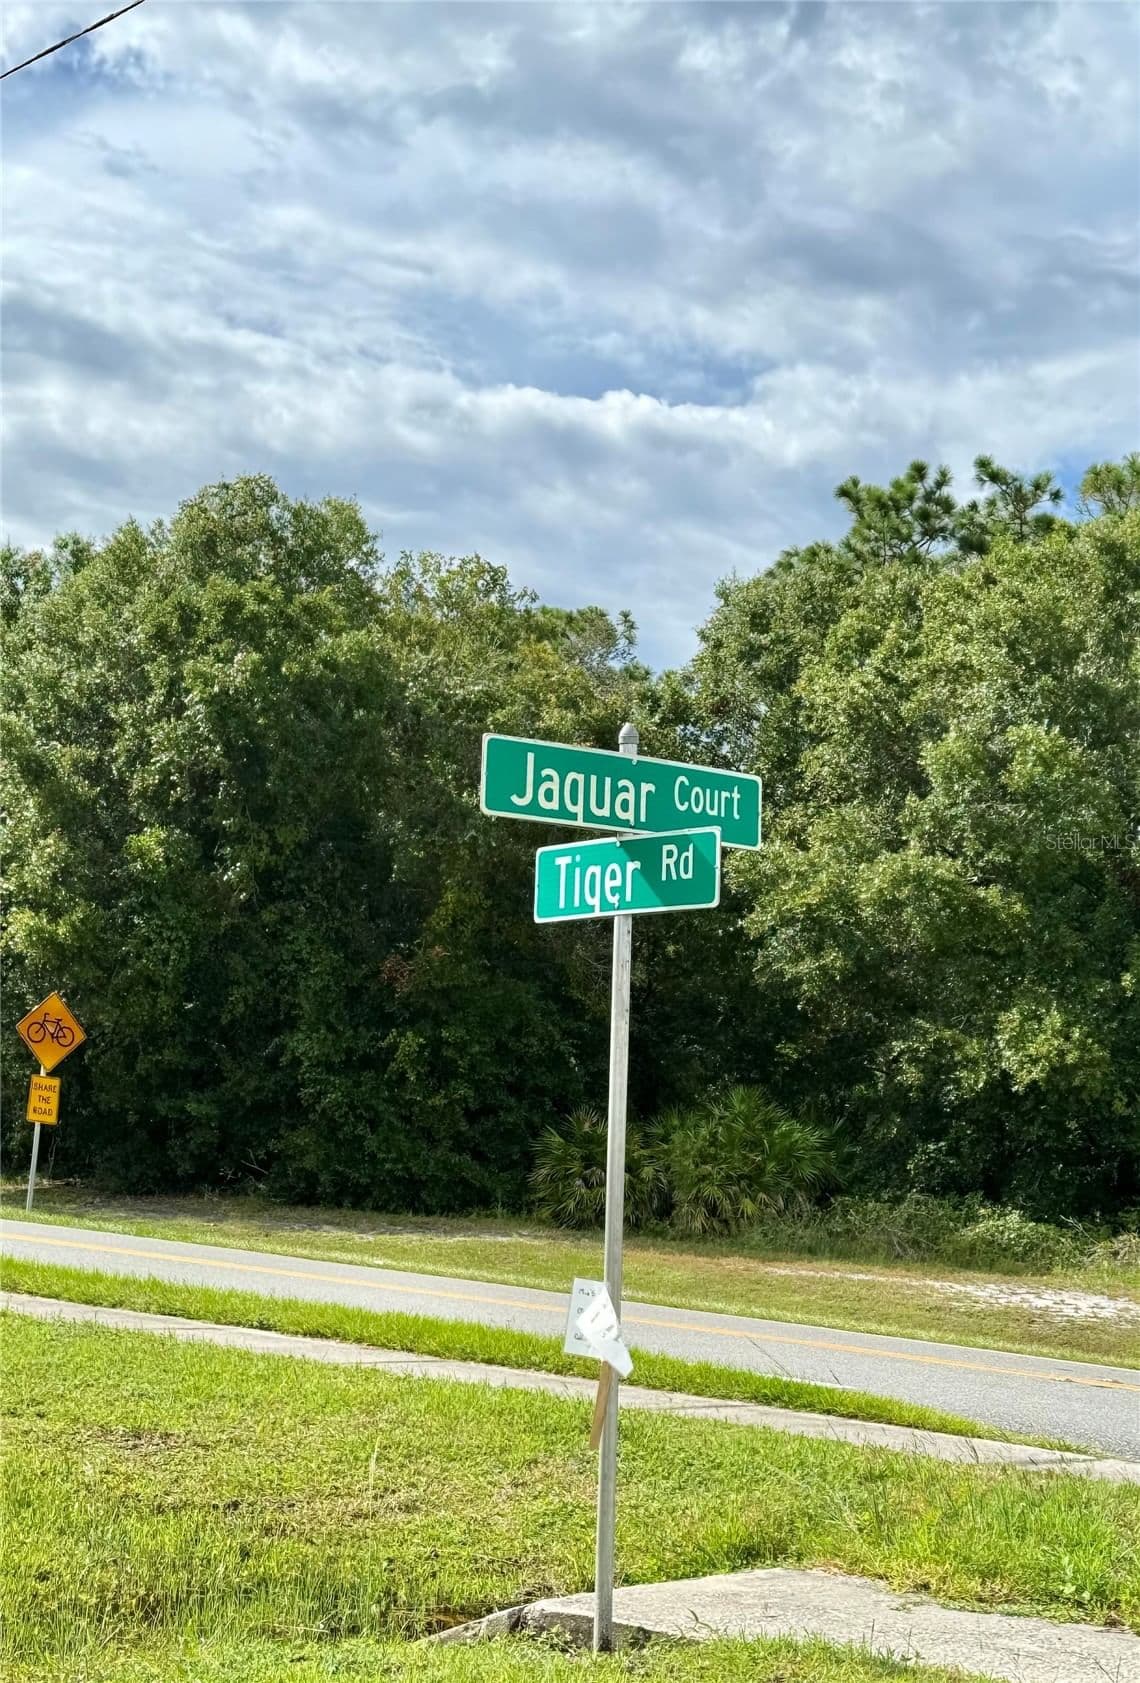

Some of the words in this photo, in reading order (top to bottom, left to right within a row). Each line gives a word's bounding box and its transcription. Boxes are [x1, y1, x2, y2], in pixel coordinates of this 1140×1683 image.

[674, 776, 741, 820] Court
[661, 843, 694, 881] Rd
[33, 1082, 57, 1094] SHARE
[38, 1094, 51, 1105] THE
[32, 1106, 53, 1116] ROAD
